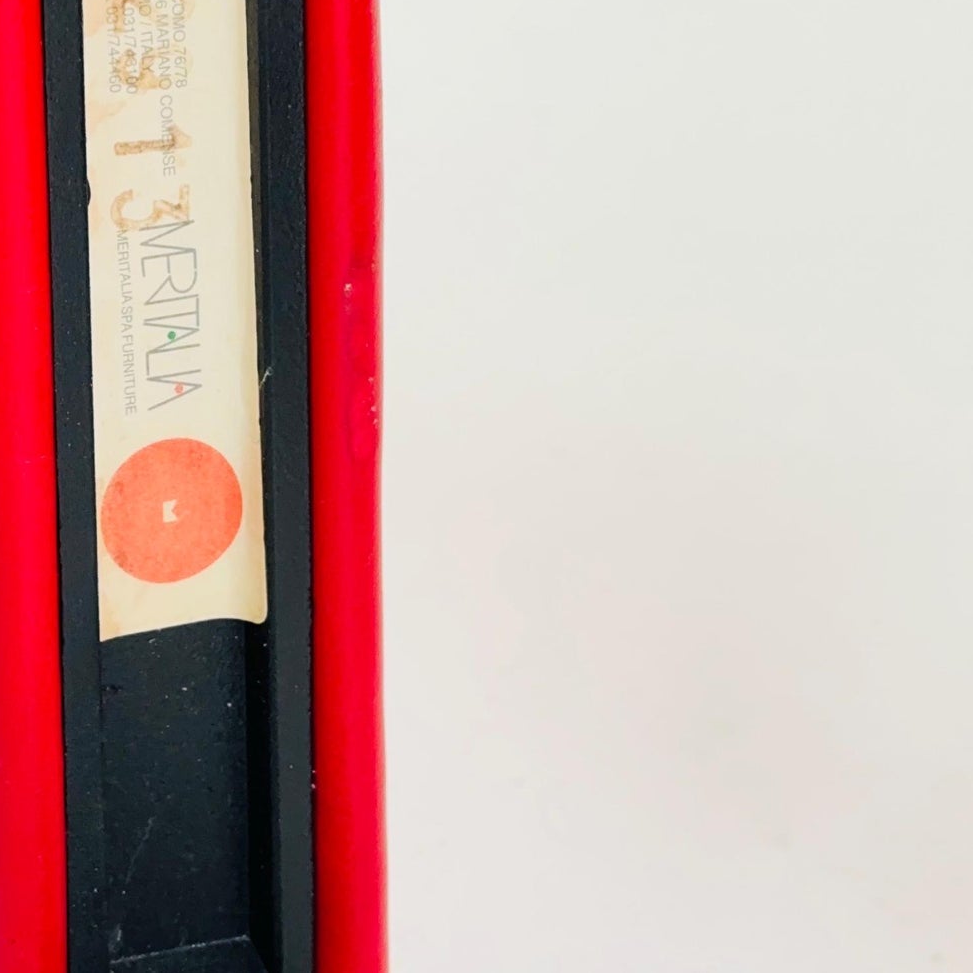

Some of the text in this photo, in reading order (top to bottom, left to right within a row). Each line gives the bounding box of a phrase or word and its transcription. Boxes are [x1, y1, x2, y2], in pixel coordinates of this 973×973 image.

[140, 30, 155, 73] ITALY
[156, 14, 172, 90] MARIANO
[174, 47, 188, 88] 76/78
[159, 94, 176, 177] COMENSE
[116, 227, 137, 416] MERITALIA SPA FURNITURE
[139, 220, 202, 411] MERITALIA
